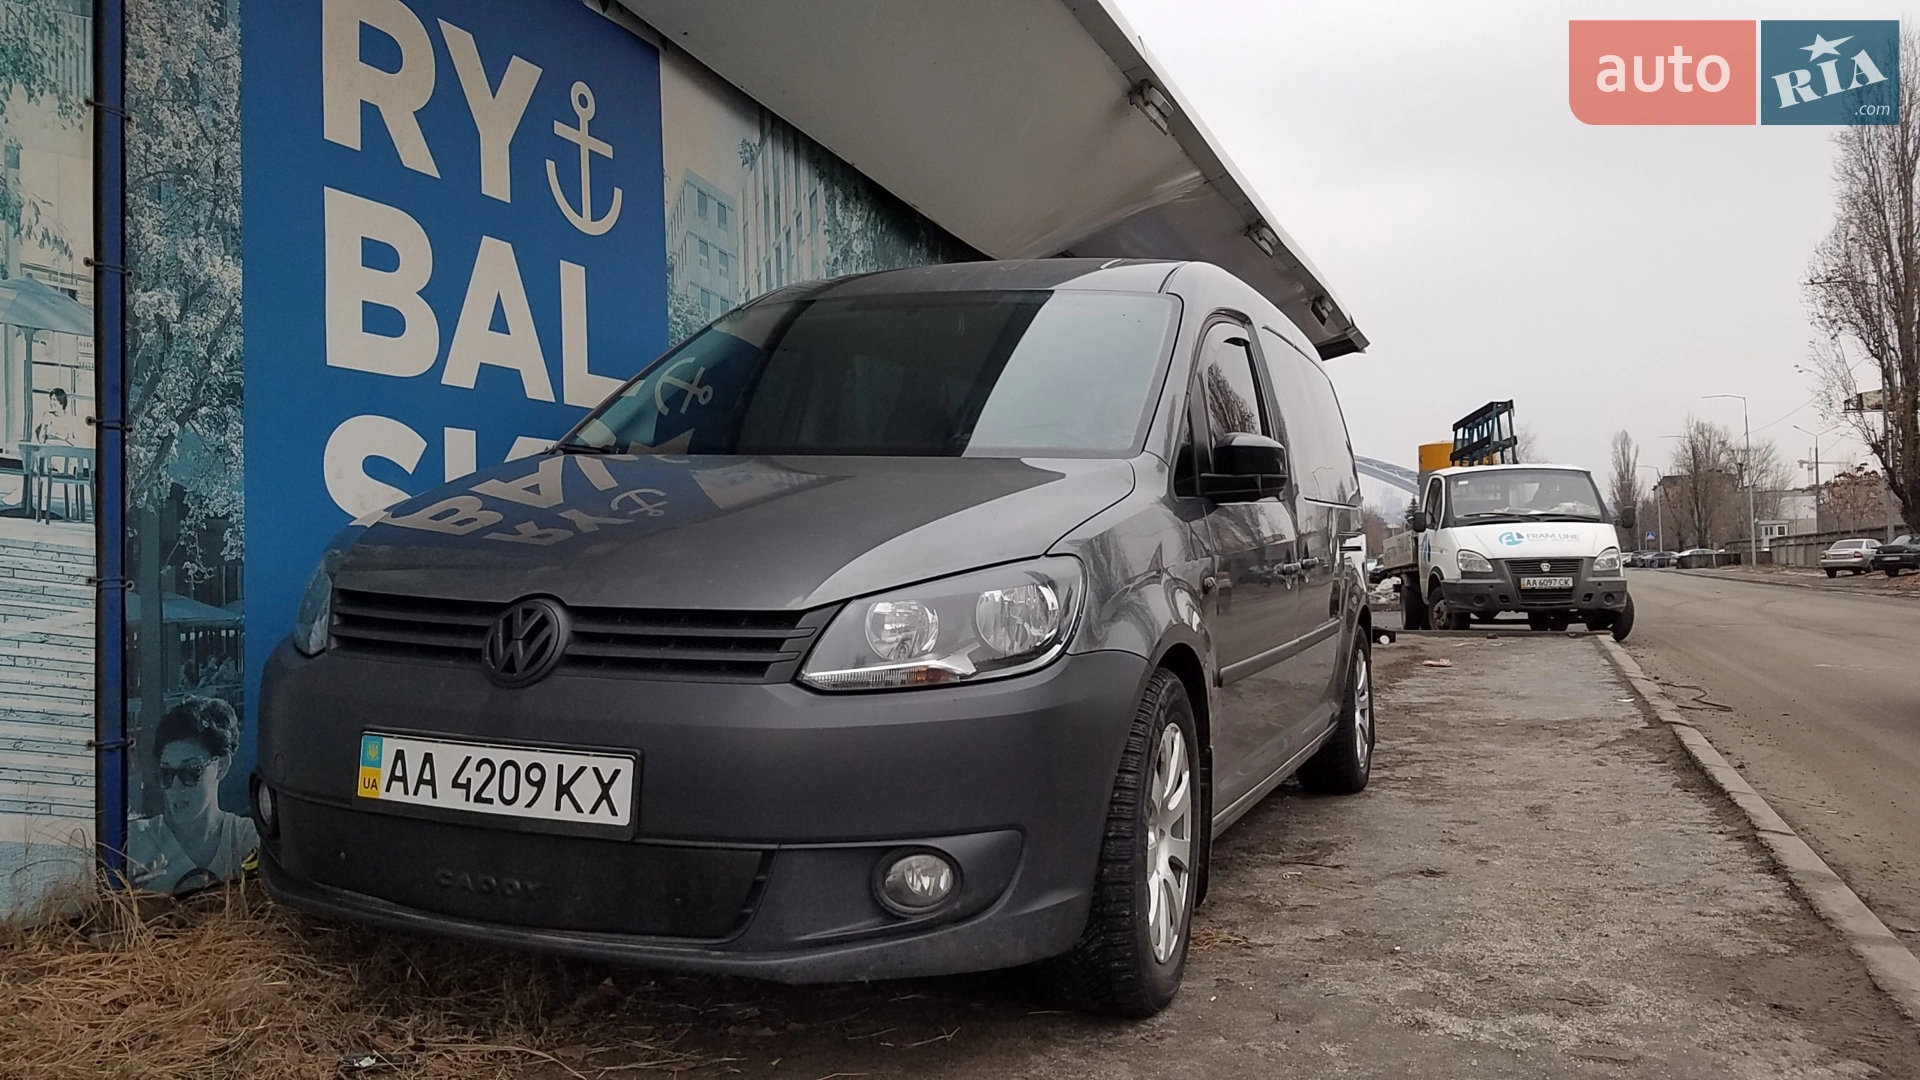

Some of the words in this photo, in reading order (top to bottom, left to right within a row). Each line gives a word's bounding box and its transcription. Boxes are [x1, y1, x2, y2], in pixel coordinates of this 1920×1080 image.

[322, 0, 543, 203] RY
[323, 186, 627, 409] BAL
[1526, 579, 1538, 587] AA
[1558, 578, 1570, 586] CK
[363, 779, 379, 791] UA
[385, 748, 438, 799] AA
